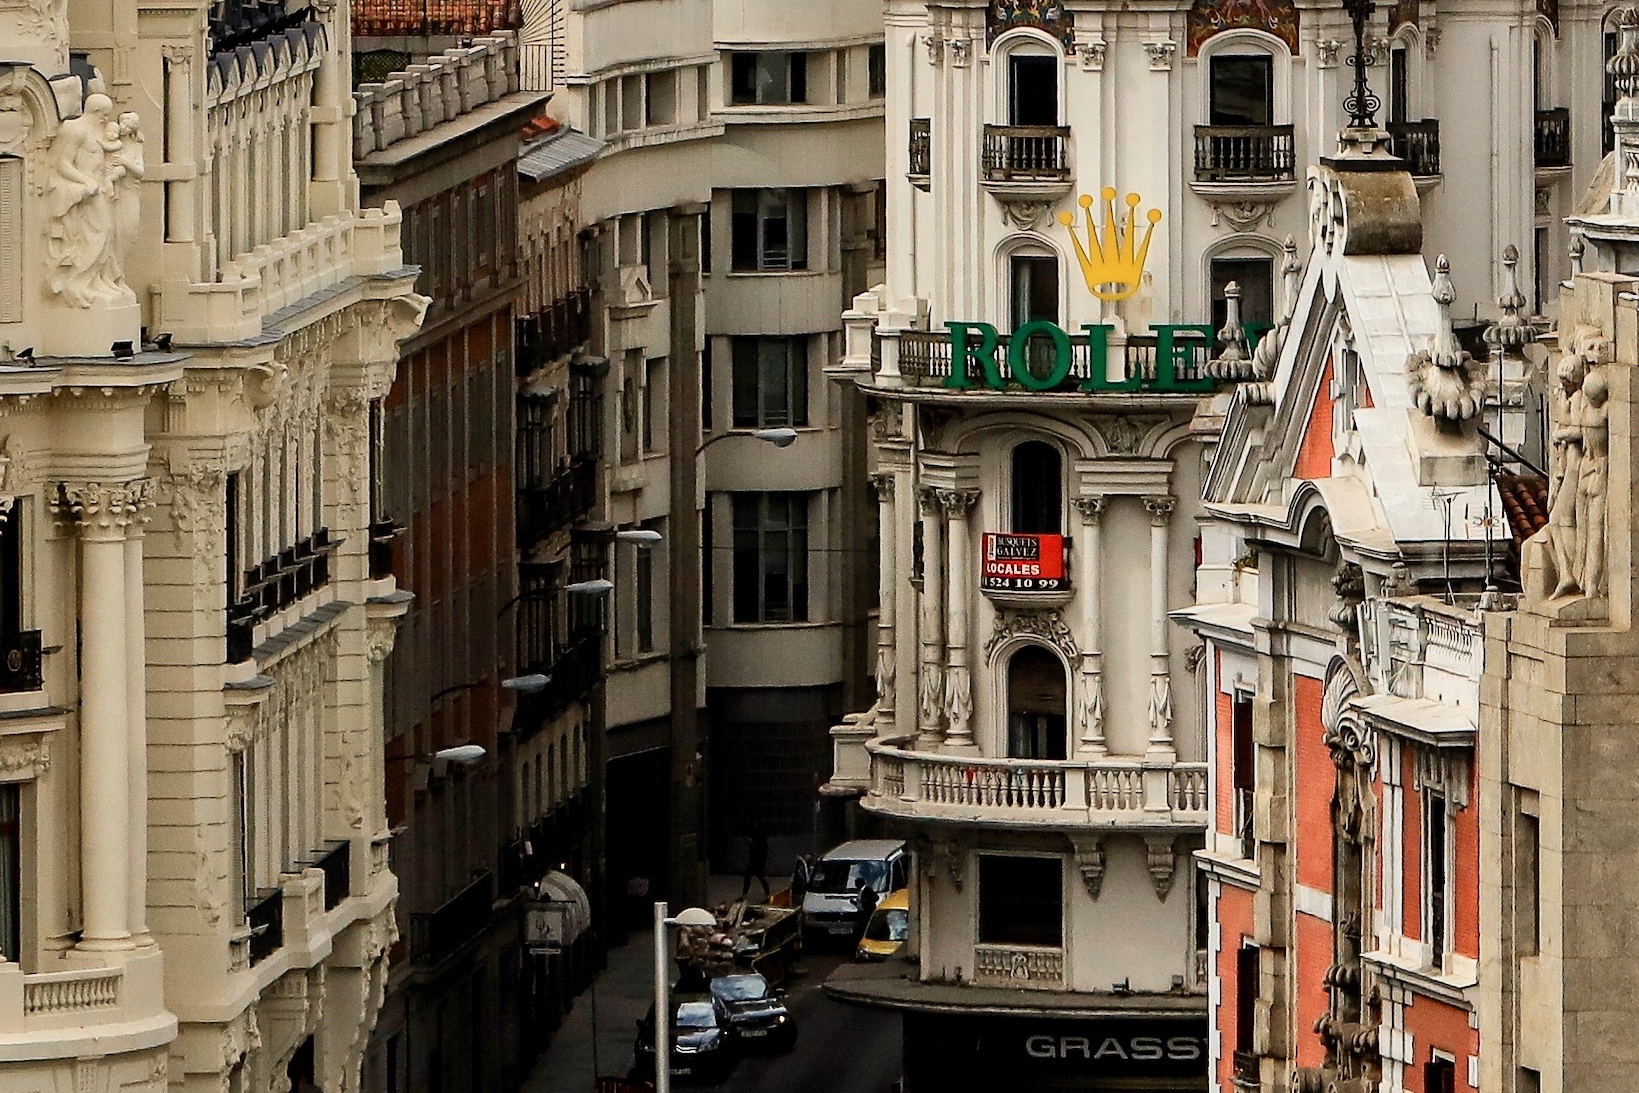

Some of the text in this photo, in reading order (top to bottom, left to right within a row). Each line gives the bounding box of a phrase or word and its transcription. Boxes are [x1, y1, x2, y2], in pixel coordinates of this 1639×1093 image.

[986, 563, 1040, 575] LOCALES
[989, 577, 1010, 588] 524
[1015, 578, 1033, 588] 10
[1038, 579, 1059, 589] 99
[1025, 1034, 1208, 1060] GRASS
